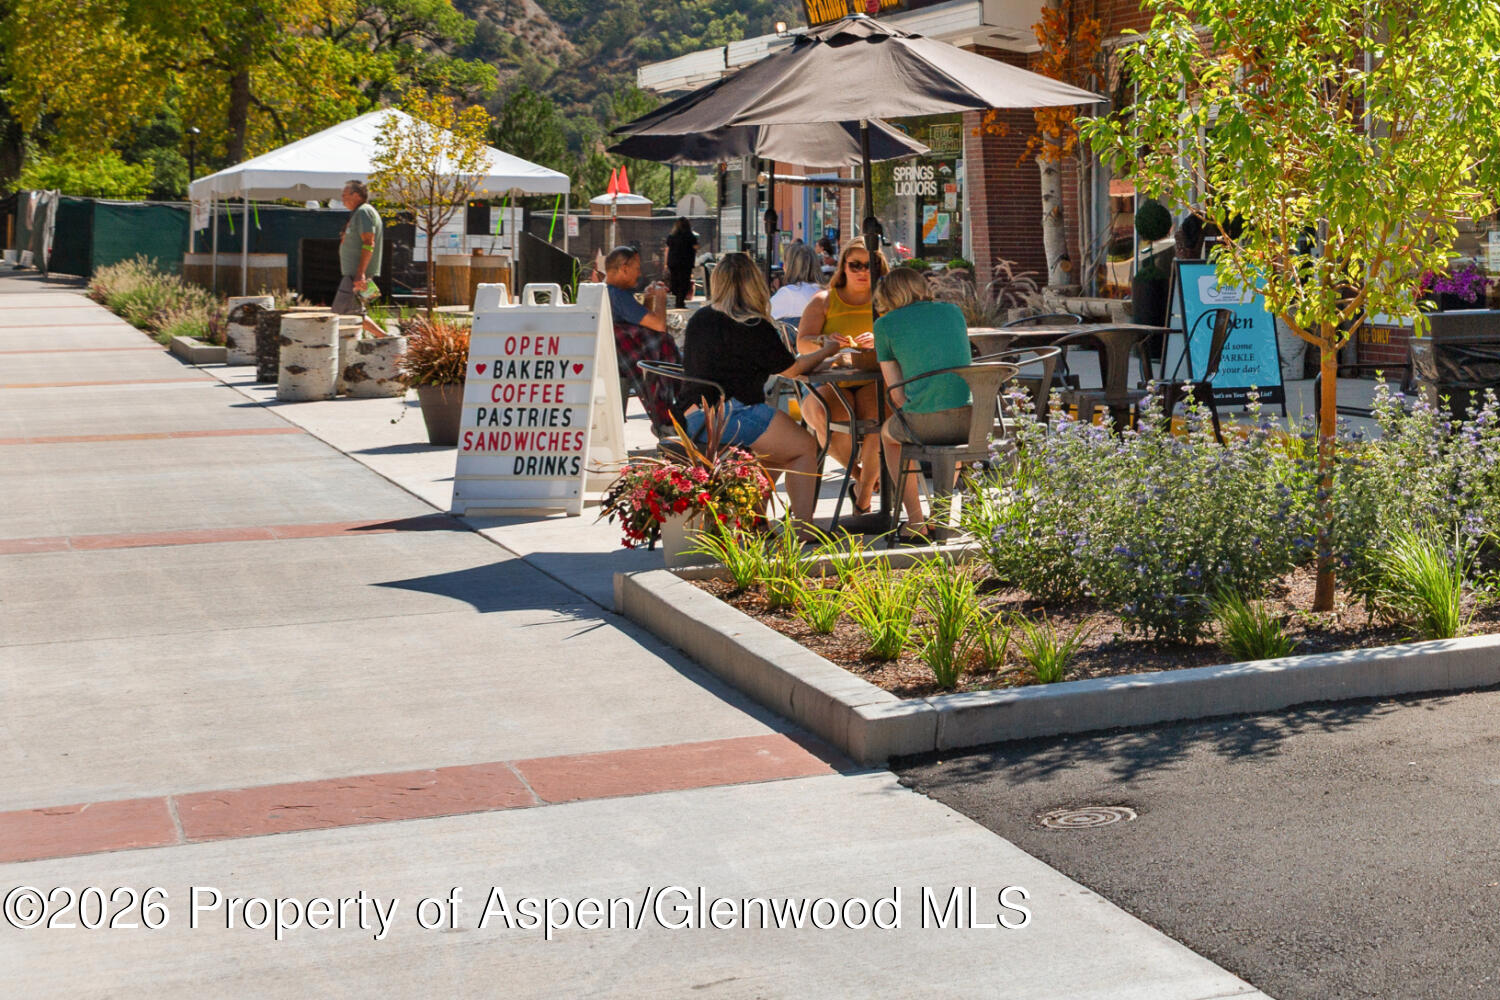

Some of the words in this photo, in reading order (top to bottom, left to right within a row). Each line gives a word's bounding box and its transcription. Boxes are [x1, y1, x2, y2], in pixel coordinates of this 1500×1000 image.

[893, 166, 934, 181] SPRINGS
[895, 182, 937, 196] LIQUORS
[504, 336, 560, 356] OPEN
[1222, 354, 1255, 362] ARKLE
[493, 360, 569, 379] BAKERY
[1222, 367, 1240, 376] your
[491, 384, 565, 404] COFFEE
[476, 407, 573, 427] PASTRIES
[463, 431, 584, 451] SANDWICHES
[513, 456, 581, 475] DRINKS
